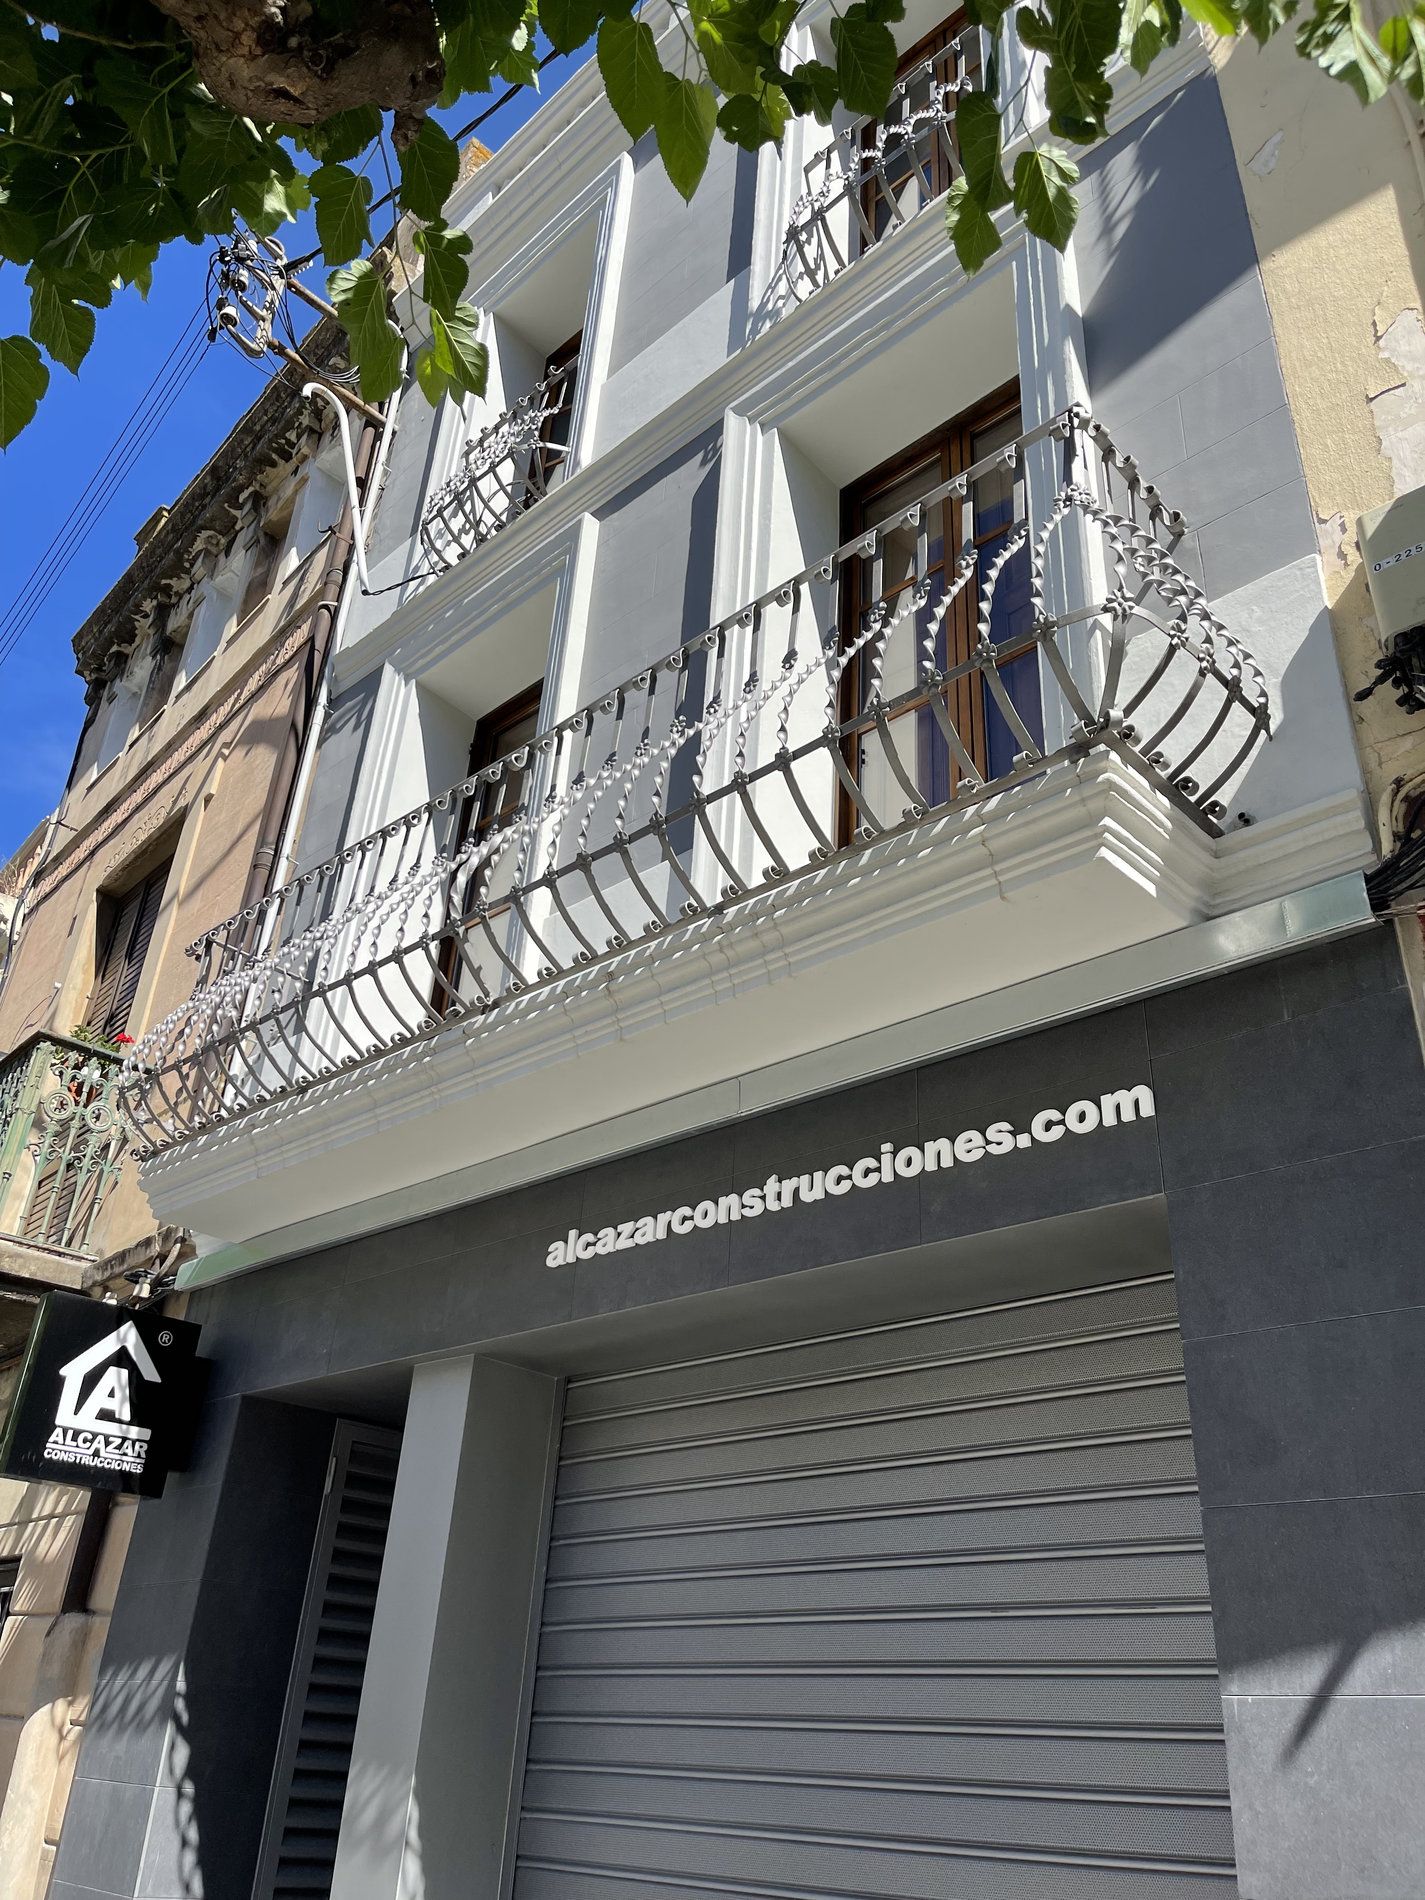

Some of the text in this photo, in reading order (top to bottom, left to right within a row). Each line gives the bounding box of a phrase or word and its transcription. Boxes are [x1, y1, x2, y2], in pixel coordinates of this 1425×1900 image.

[544, 1083, 1156, 1268] alcazarconstrucciones.com
[48, 1426, 148, 1458] ALCAZAR
[43, 1448, 144, 1473] CONSTRUCCIONES
